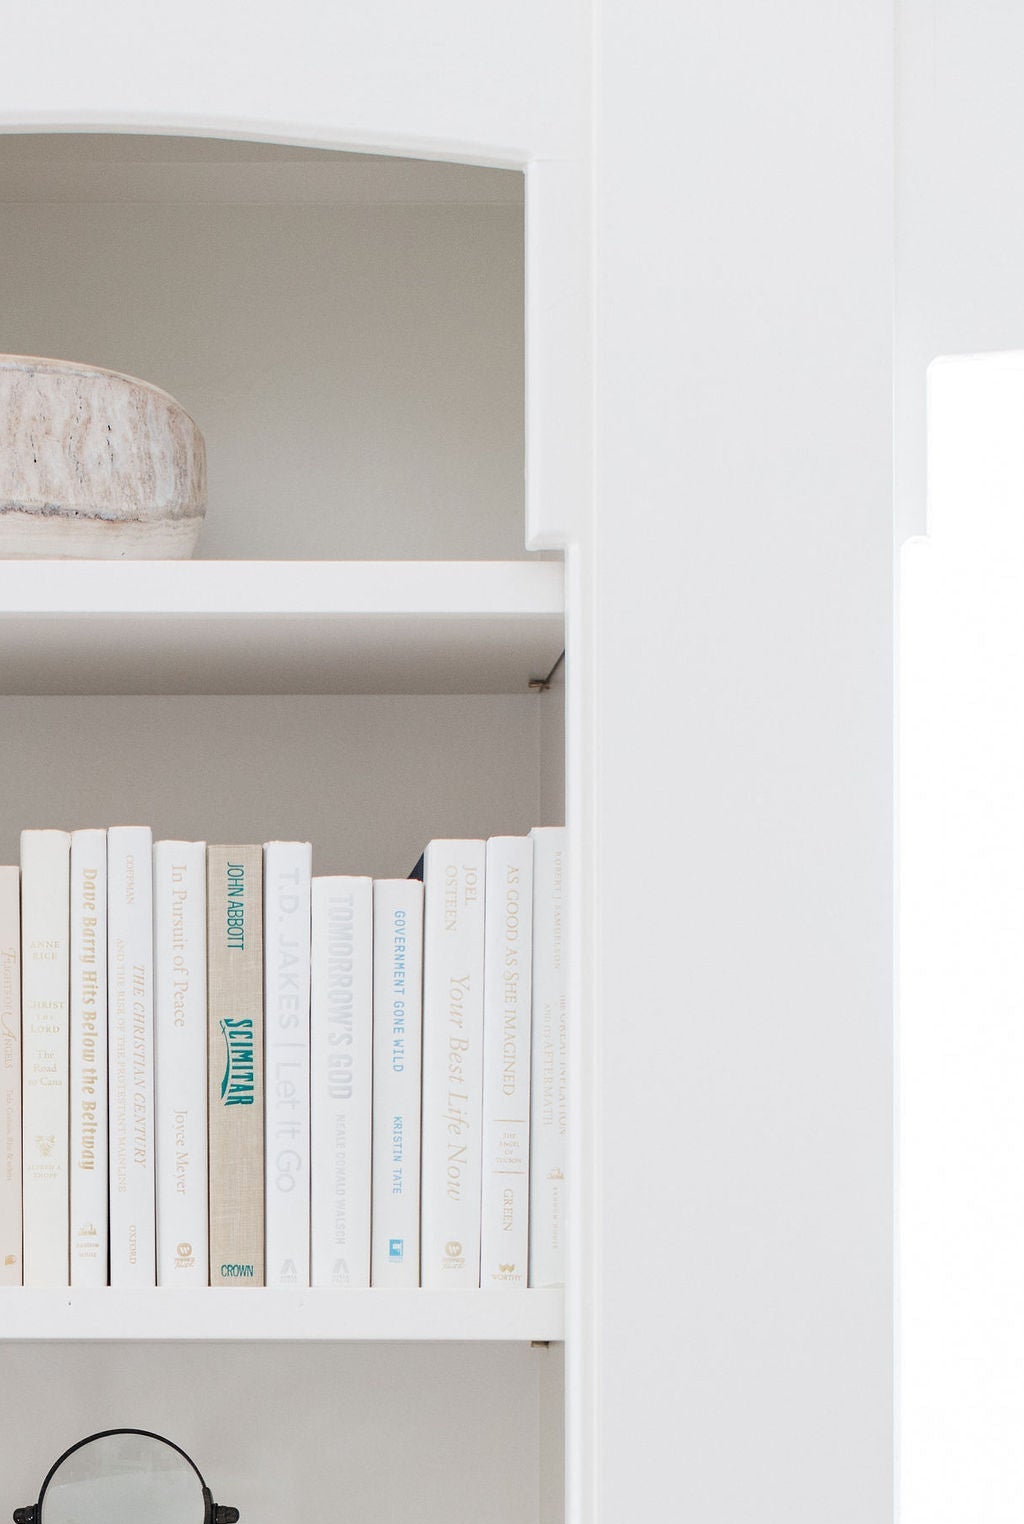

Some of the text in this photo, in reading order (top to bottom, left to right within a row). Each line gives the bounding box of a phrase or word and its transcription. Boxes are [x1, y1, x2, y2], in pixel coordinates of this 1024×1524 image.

[125, 854, 135, 905] COFFMAN
[226, 861, 244, 950] JOHN ABBOTT
[444, 864, 458, 932] OSTEEN
[463, 864, 478, 906] JOEL
[171, 863, 189, 1027] In Pursuit of Peace
[501, 865, 520, 1097] AS GOOD AS SHE IMAGINED
[79, 868, 100, 1171] Dave Barry Hits Below the Beltway
[276, 867, 302, 1193] T.D. JAKES Let It Go
[327, 894, 354, 1100] TOMORROW'S GOD
[392, 910, 406, 1073] GOVERNMENT GONE WILD
[133, 964, 148, 1169] THE CHRISTIAN CENTURY
[224, 1018, 254, 1107] SCIMITAR
[442, 974, 470, 1201] Your Best Life Now
[171, 1109, 188, 1195] Joyce Meyer
[335, 1153, 346, 1197] DONALD
[392, 1116, 403, 1195] KRISTIN TATE
[129, 1224, 137, 1265] OXFORD
[502, 1188, 515, 1232] GREEN
[220, 1264, 254, 1277] CROWN
